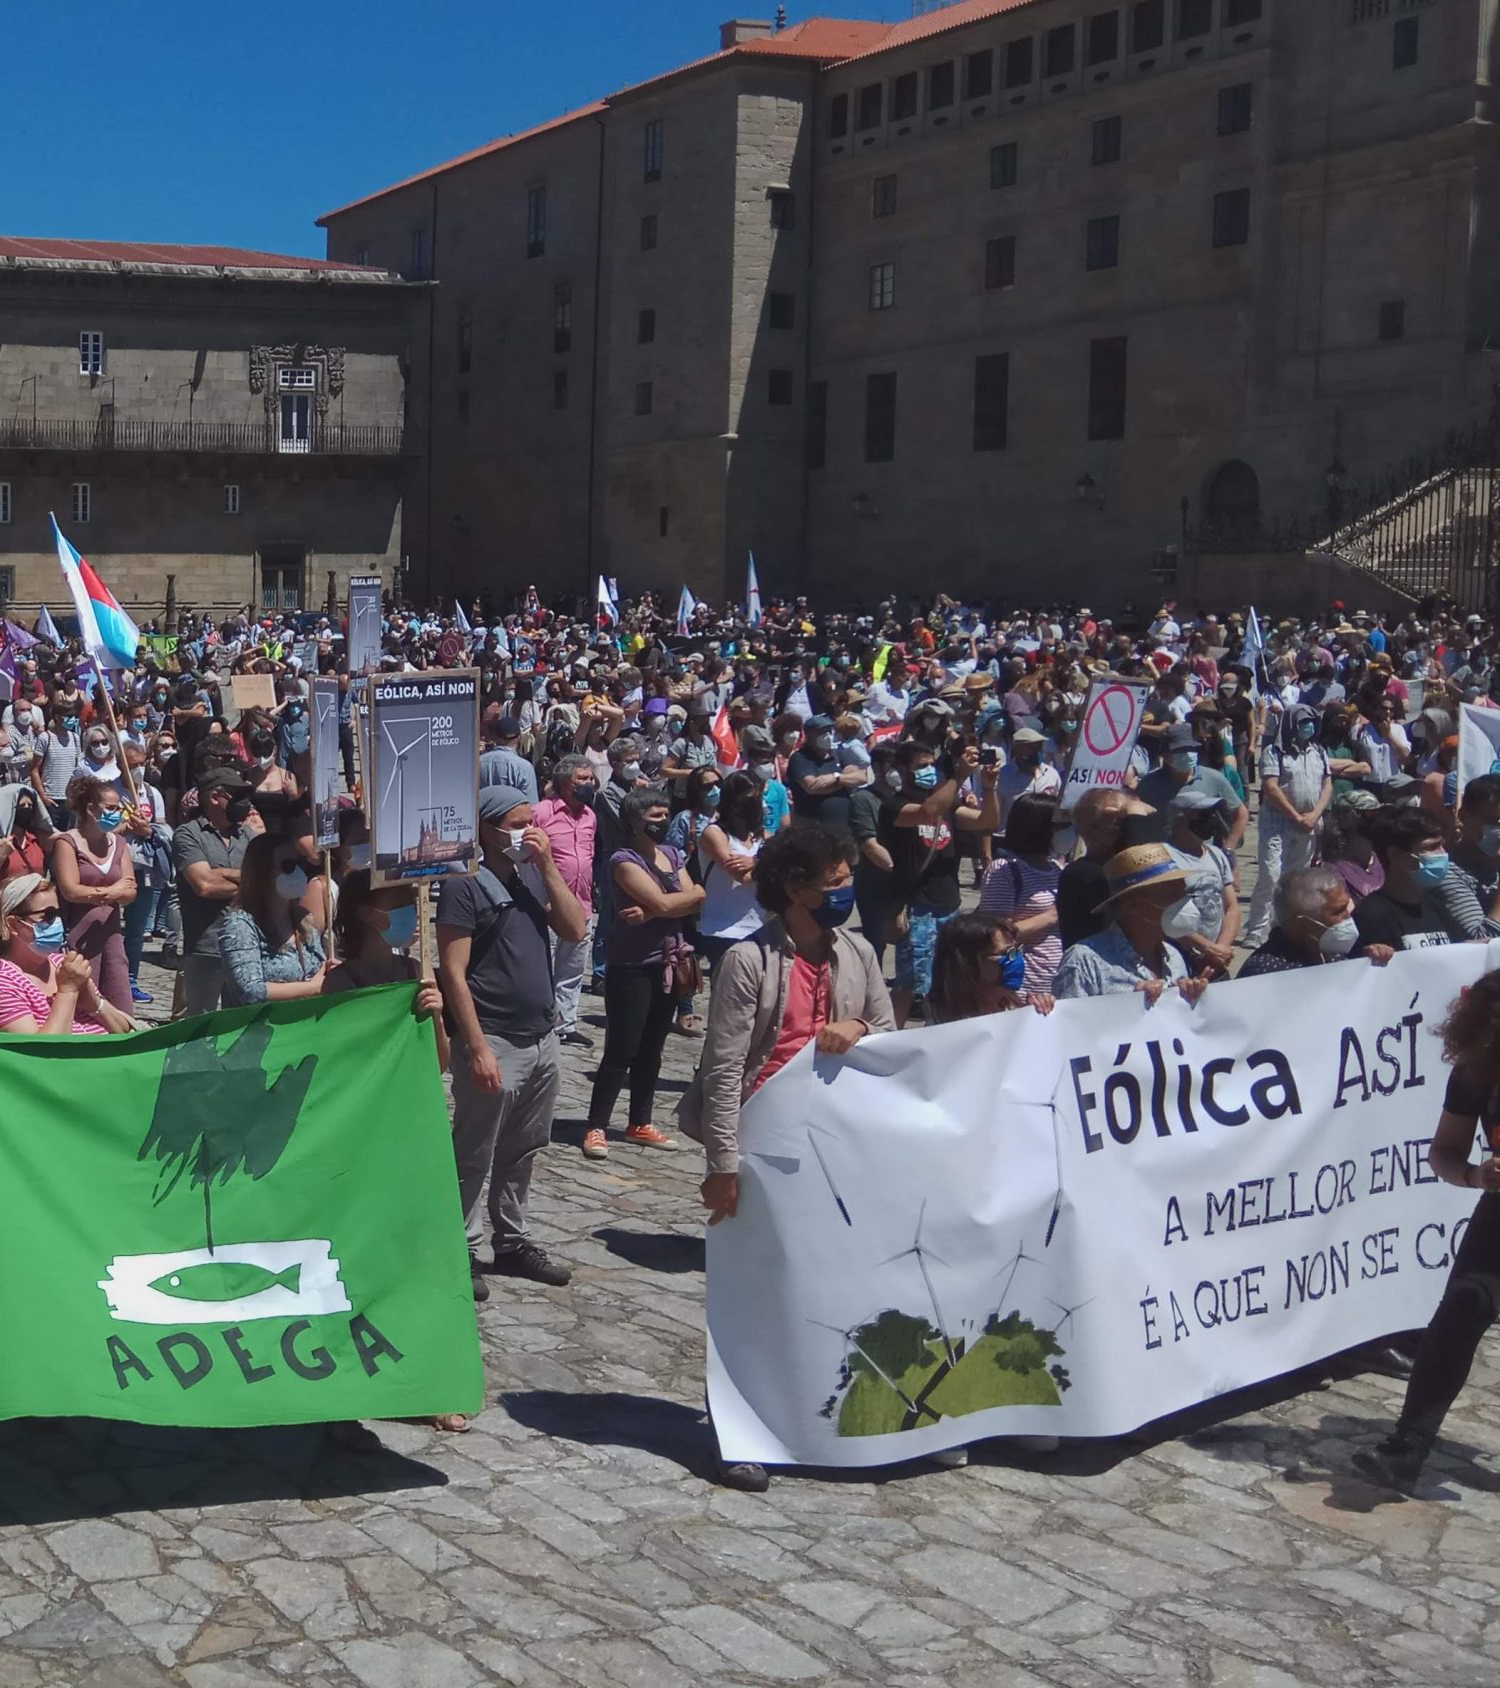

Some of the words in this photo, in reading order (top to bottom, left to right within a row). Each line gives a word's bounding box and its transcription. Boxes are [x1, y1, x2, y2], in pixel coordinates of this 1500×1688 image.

[375, 685, 423, 700] EÓLICA,
[425, 681, 445, 697] ASÍ
[448, 682, 474, 695] NON
[432, 716, 453, 729] 200
[1094, 769, 1126, 785] NON
[443, 806, 456, 817] 75
[1069, 1038, 1302, 1154] Eólica
[1333, 991, 1425, 1109] ASÍ
[1164, 1196, 1189, 1246] A
[1204, 1159, 1356, 1236] MELLOR
[1139, 1285, 1162, 1350] É
[1169, 1290, 1190, 1343] A
[1193, 1266, 1269, 1329] QUE
[1284, 1240, 1349, 1310] NON
[1361, 1228, 1399, 1280] SE
[105, 1312, 405, 1391] ADEGA
